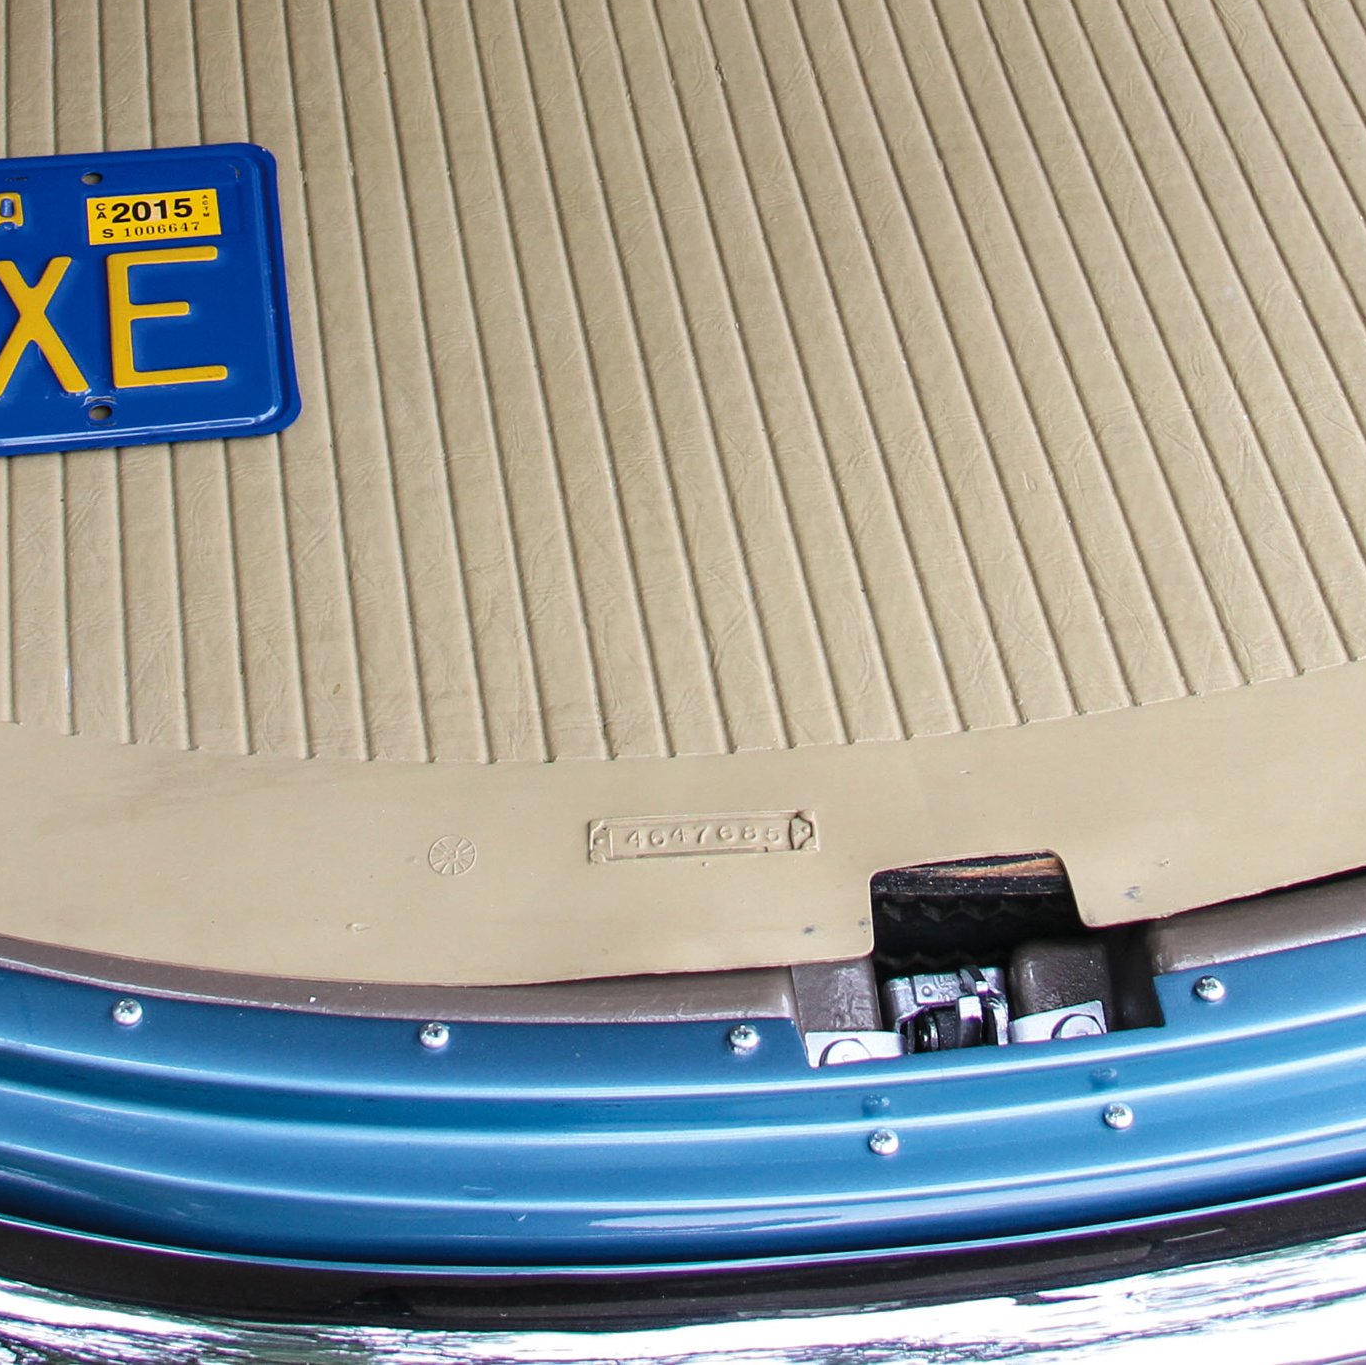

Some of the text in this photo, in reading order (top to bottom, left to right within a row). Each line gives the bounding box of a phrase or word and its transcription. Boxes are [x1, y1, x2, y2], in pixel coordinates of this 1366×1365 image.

[95, 202, 107, 220] CA
[111, 198, 193, 224] 2015
[102, 221, 200, 239] S 1006647
